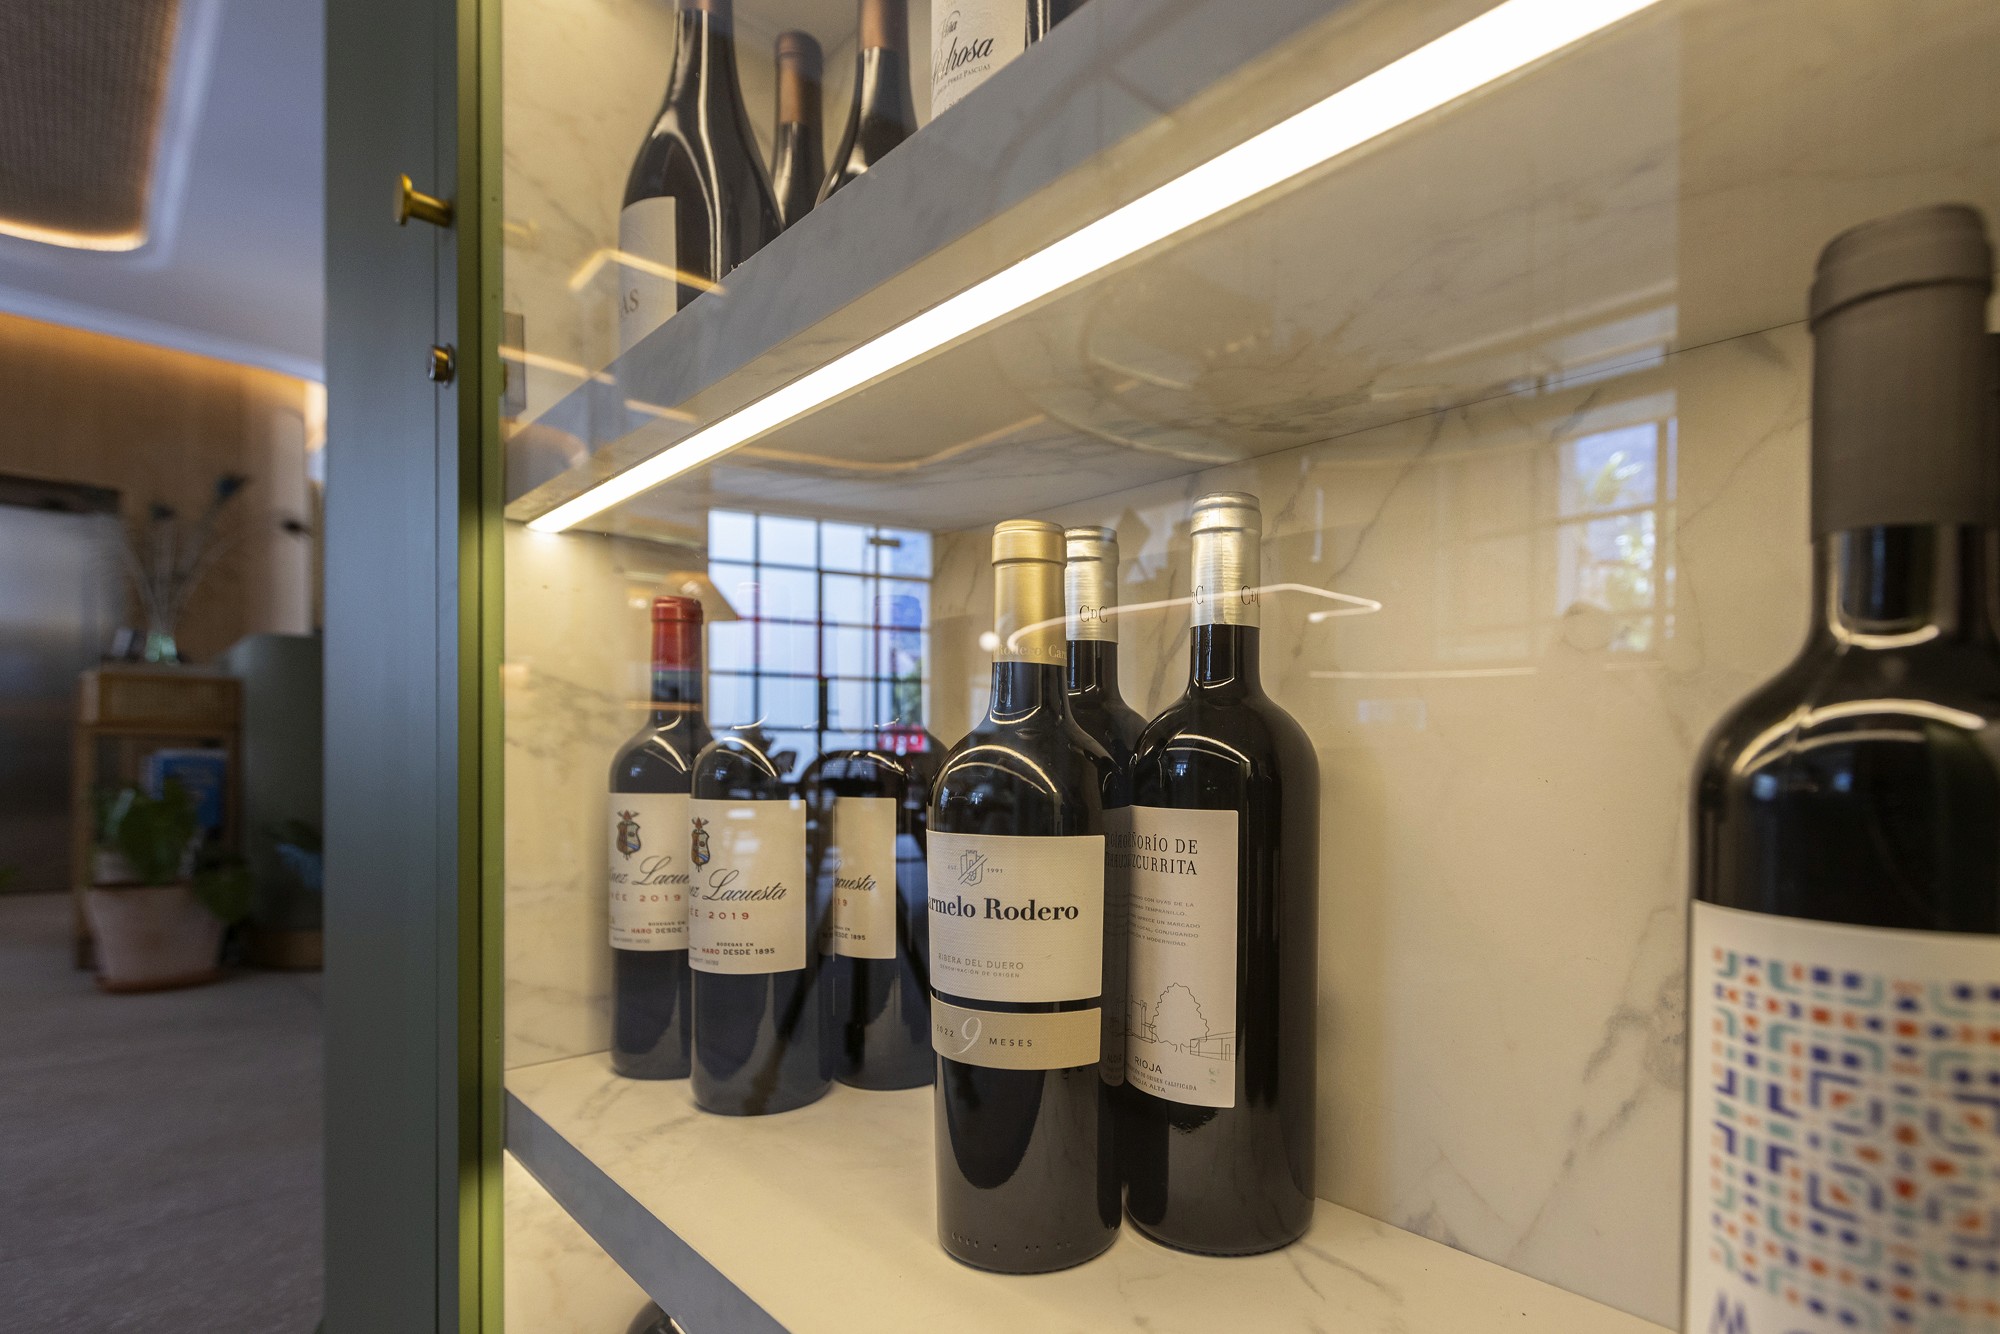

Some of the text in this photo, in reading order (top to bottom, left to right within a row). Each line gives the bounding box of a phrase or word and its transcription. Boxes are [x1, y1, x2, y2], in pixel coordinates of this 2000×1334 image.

[1175, 838, 1199, 855] DE
[986, 866, 1004, 874] 1991
[701, 867, 788, 902] Lacuesta
[639, 894, 681, 903] 2019
[708, 911, 750, 920] 2019
[983, 896, 1080, 921] Rodero
[701, 947, 776, 956] HARO DESDE 1895
[938, 952, 1025, 971] RIBERA DEL DUERO
[981, 969, 991, 977] DE
[992, 970, 1020, 979] ORIGEN
[936, 1016, 1033, 1055] 2022 9 MESES
[1134, 1055, 1163, 1075] RIOJA
[1148, 1083, 1167, 1094] ALTA
